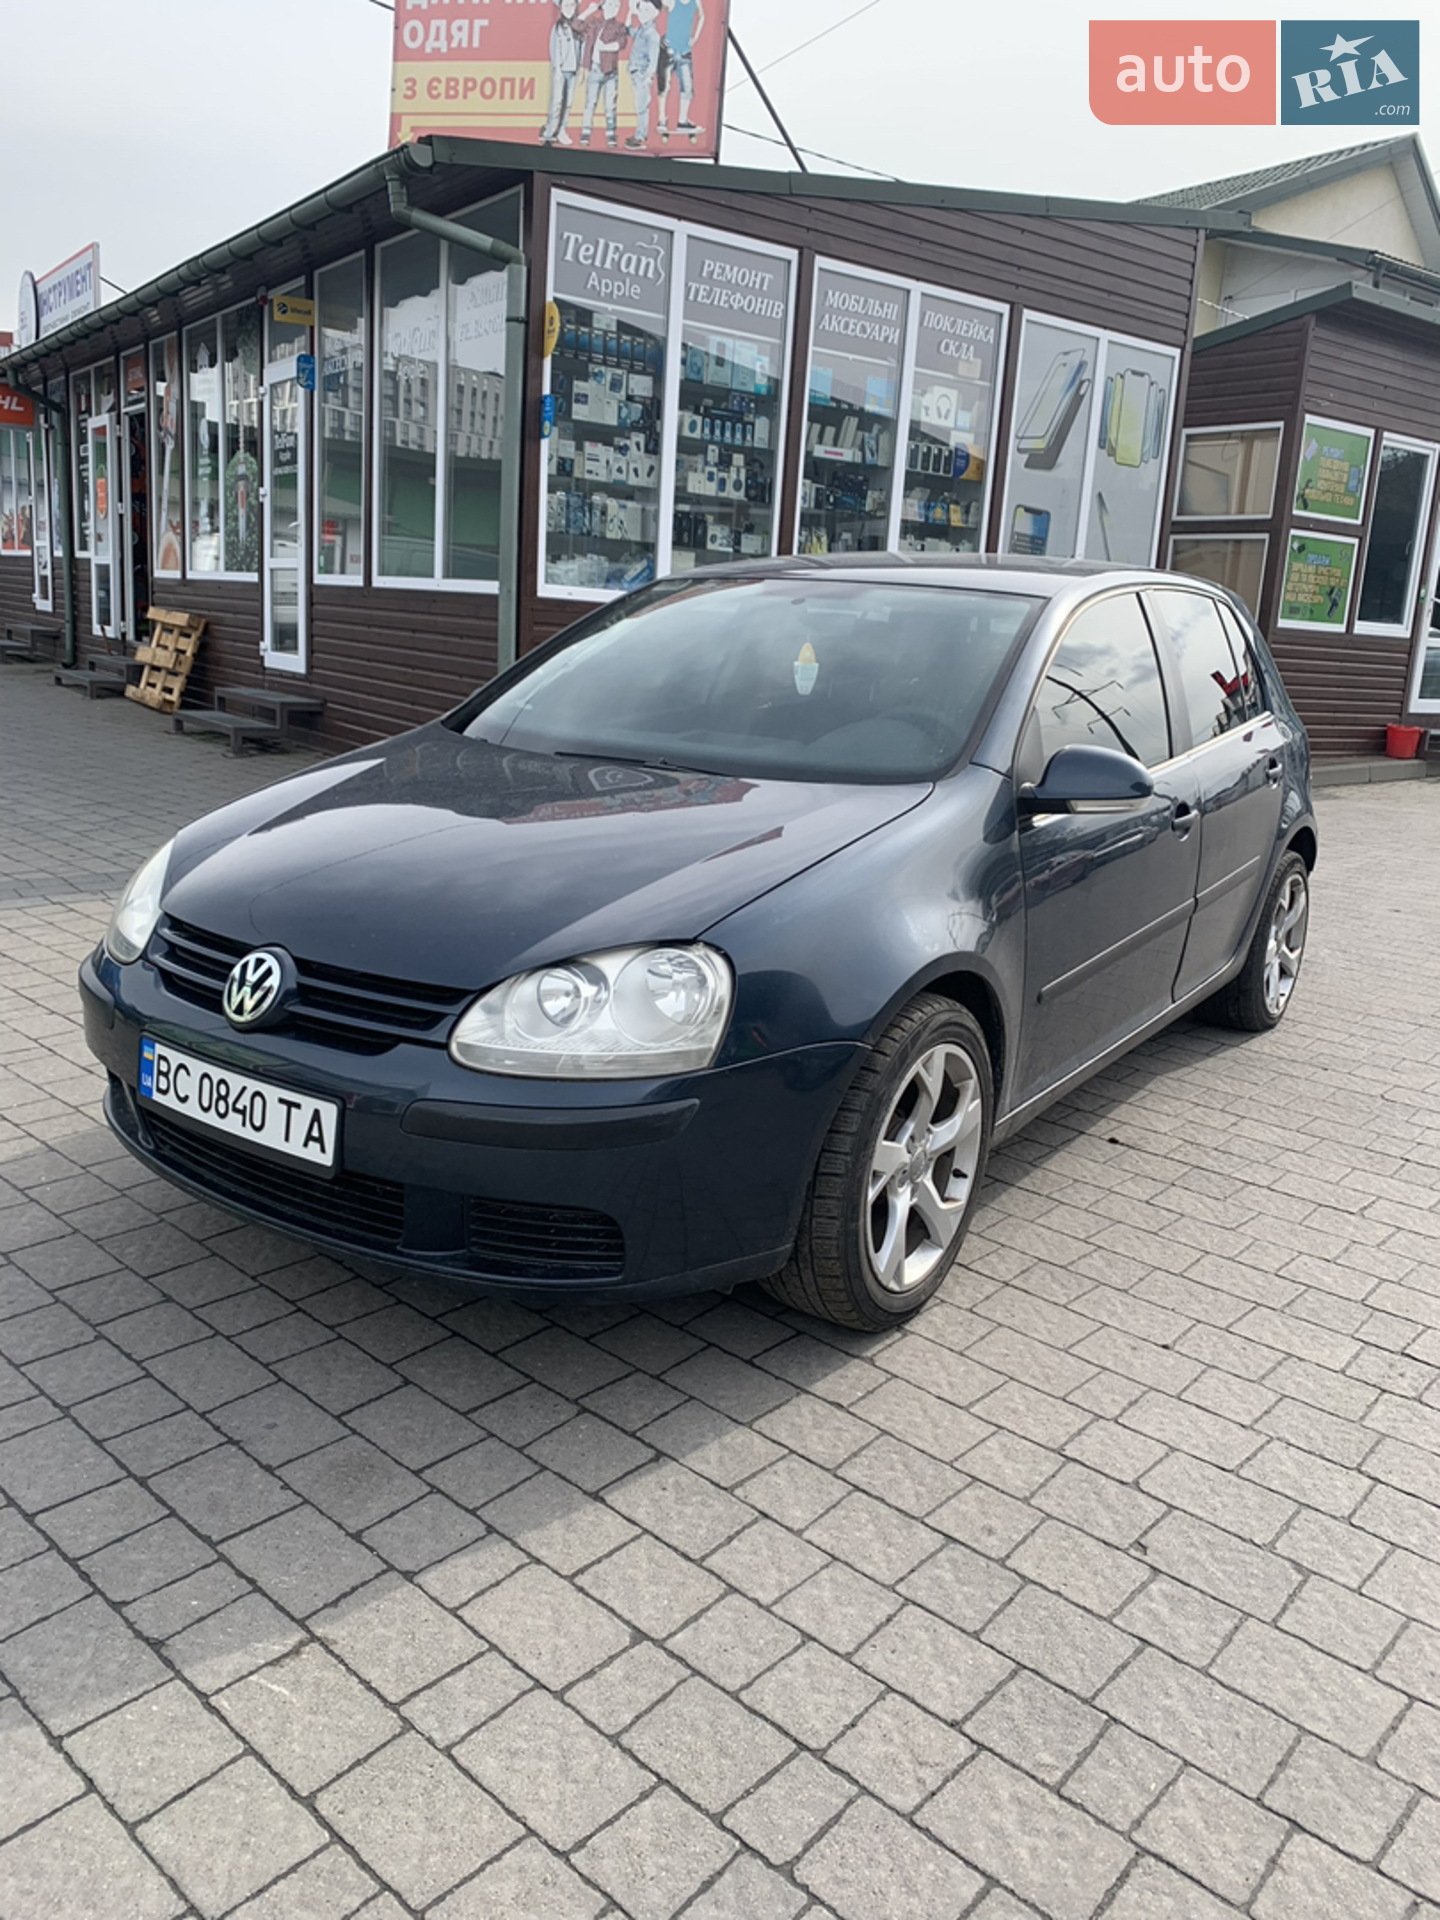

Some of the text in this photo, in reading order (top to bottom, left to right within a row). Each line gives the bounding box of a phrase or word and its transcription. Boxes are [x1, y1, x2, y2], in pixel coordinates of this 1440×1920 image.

[402, 18, 490, 54] ОДЯГ
[402, 77, 537, 101] З ЄВРОПИ
[561, 230, 656, 280] TelFan
[585, 270, 642, 300] Apple
[701, 258, 774, 292] РЕМОНТ
[687, 281, 785, 320] ТЕЛЕФОНІВ
[824, 288, 899, 322] МОБІЛЬНІ
[818, 312, 900, 346] АКСЕСУАРИ
[922, 308, 996, 345] ПОКЛЕЙКА
[939, 337, 975, 362] СКЛА
[156, 1053, 327, 1155] BC 0840 TA
